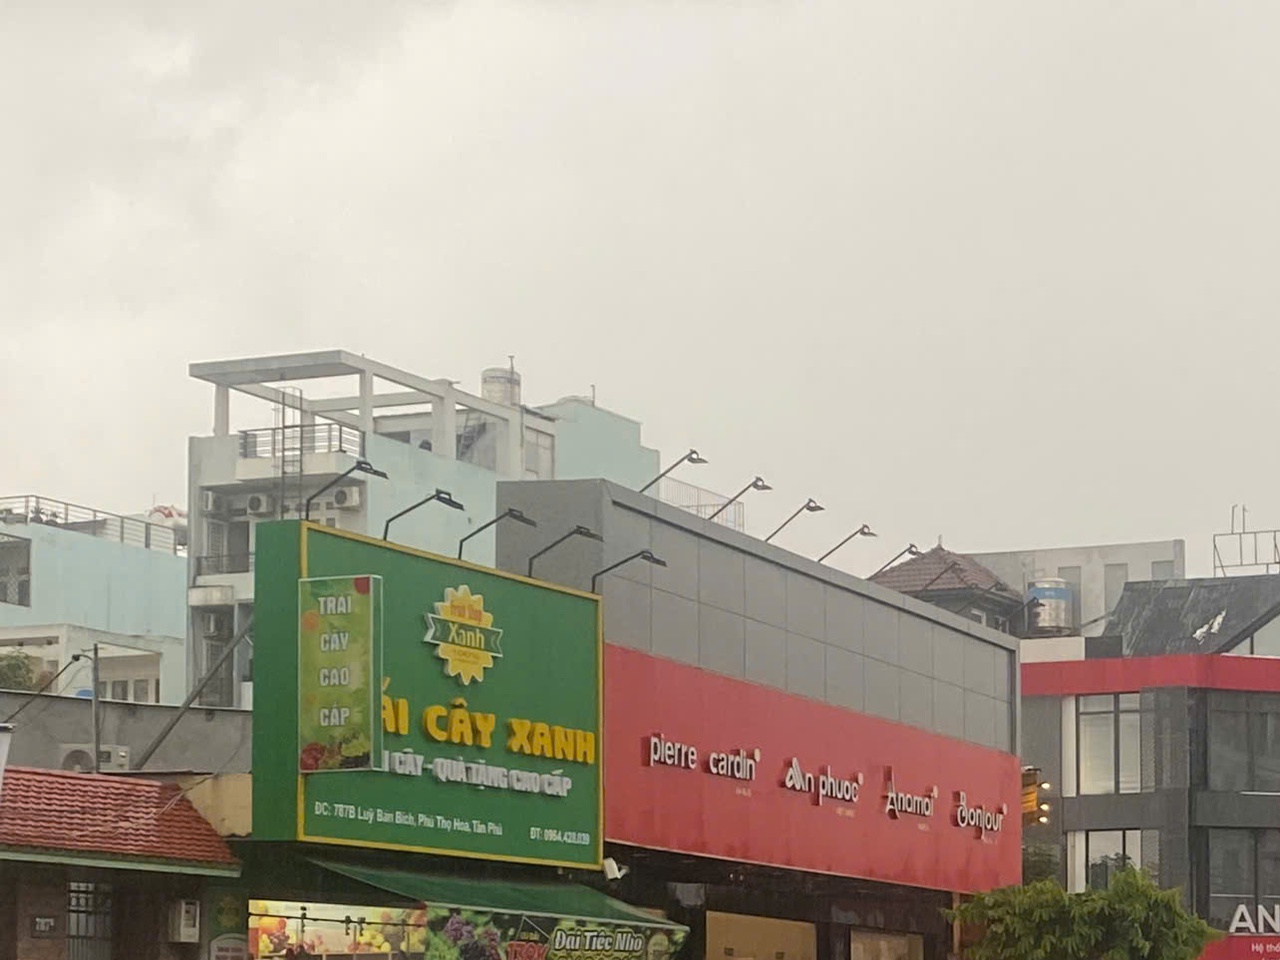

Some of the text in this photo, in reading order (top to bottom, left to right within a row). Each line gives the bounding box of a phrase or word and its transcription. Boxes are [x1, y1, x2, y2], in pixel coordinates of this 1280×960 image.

[448, 621, 485, 650] Xanh
[319, 668, 350, 687] CAO
[424, 697, 496, 748] CÂY
[508, 717, 596, 765] XANH
[649, 733, 756, 781] pierre cardin
[957, 791, 1004, 840] Bonjour
